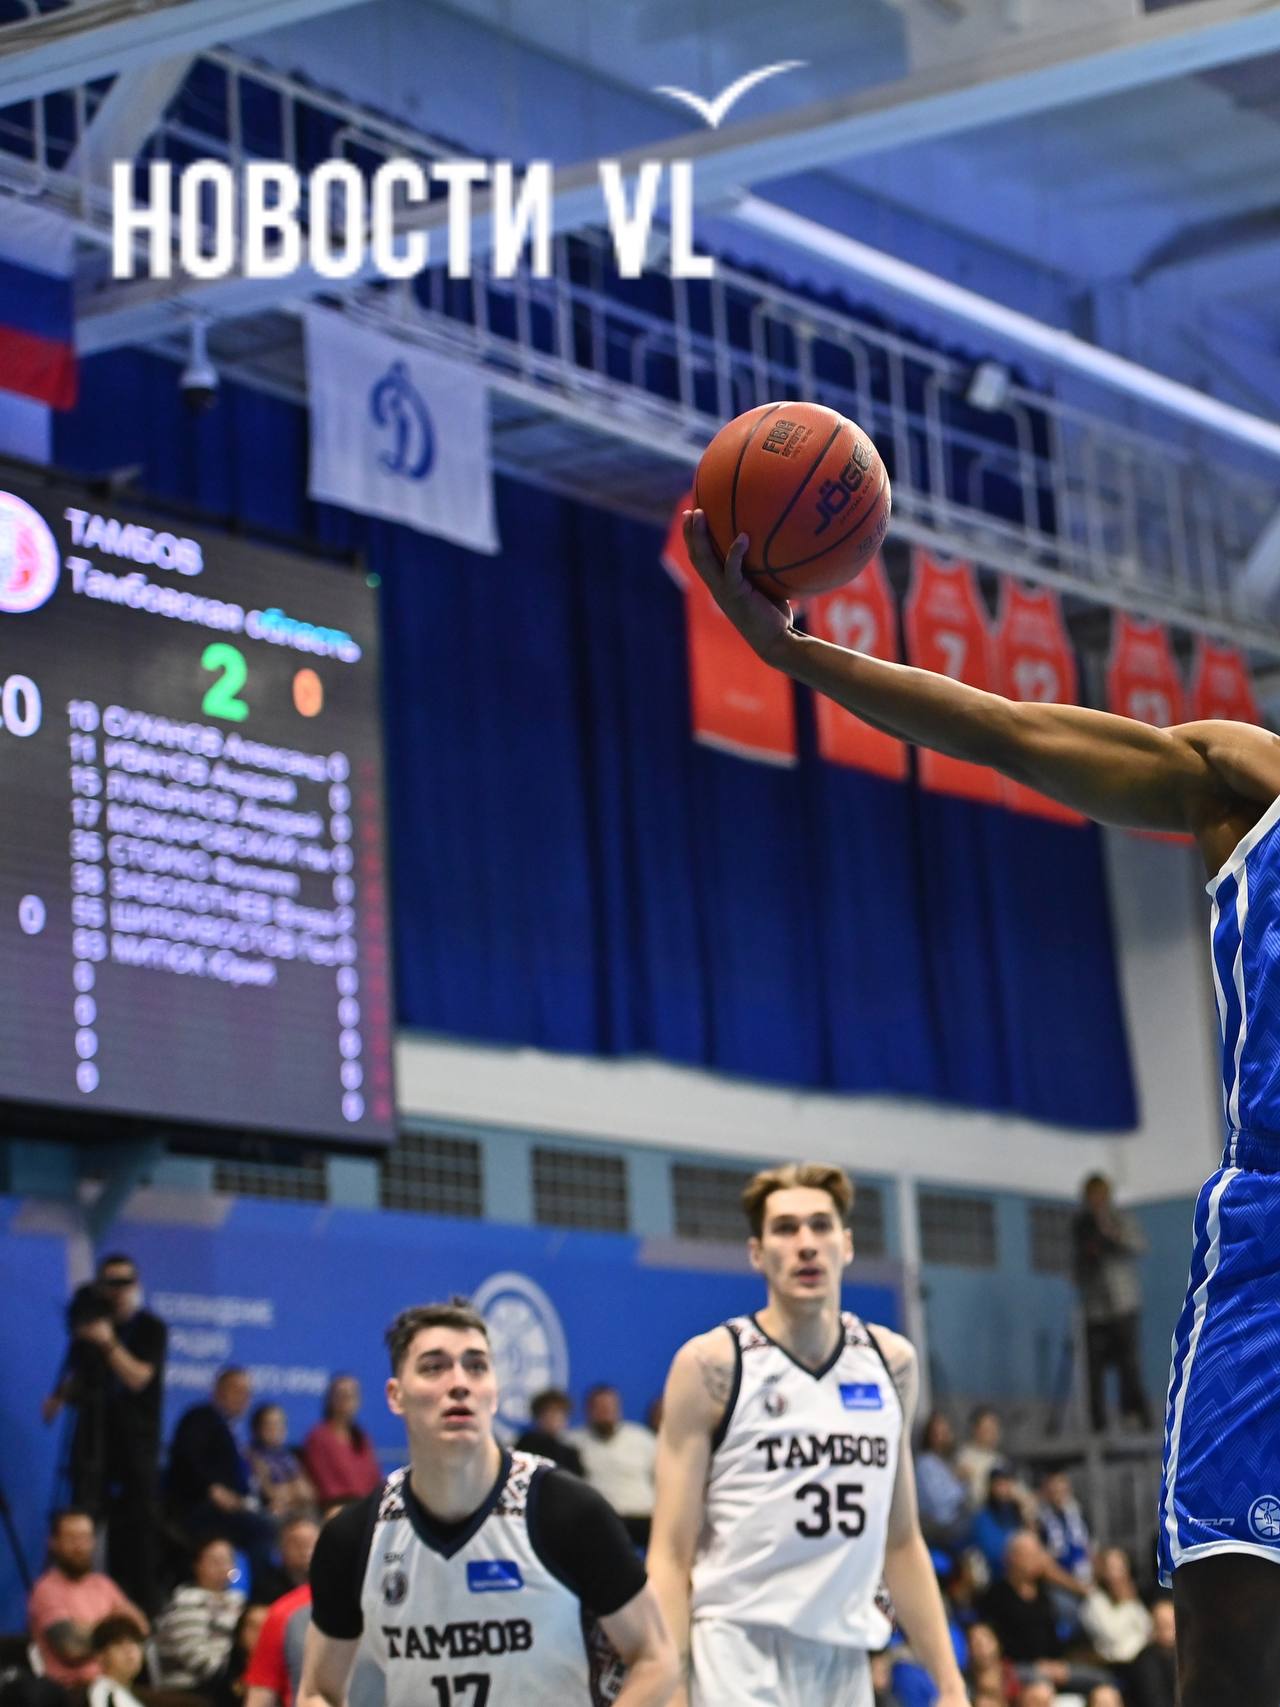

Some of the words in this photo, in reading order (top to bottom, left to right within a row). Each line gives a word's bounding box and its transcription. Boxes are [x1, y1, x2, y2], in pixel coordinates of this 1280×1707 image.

[814, 440, 875, 536] JÖGE
[64, 507, 204, 577] ТАМБОВ
[201, 643, 249, 723] 2
[756, 1433, 889, 1472] ТАМБОВ
[795, 1482, 867, 1539] 35
[381, 1617, 534, 1661] ТАМБОВ
[431, 1671, 491, 1707] 17
